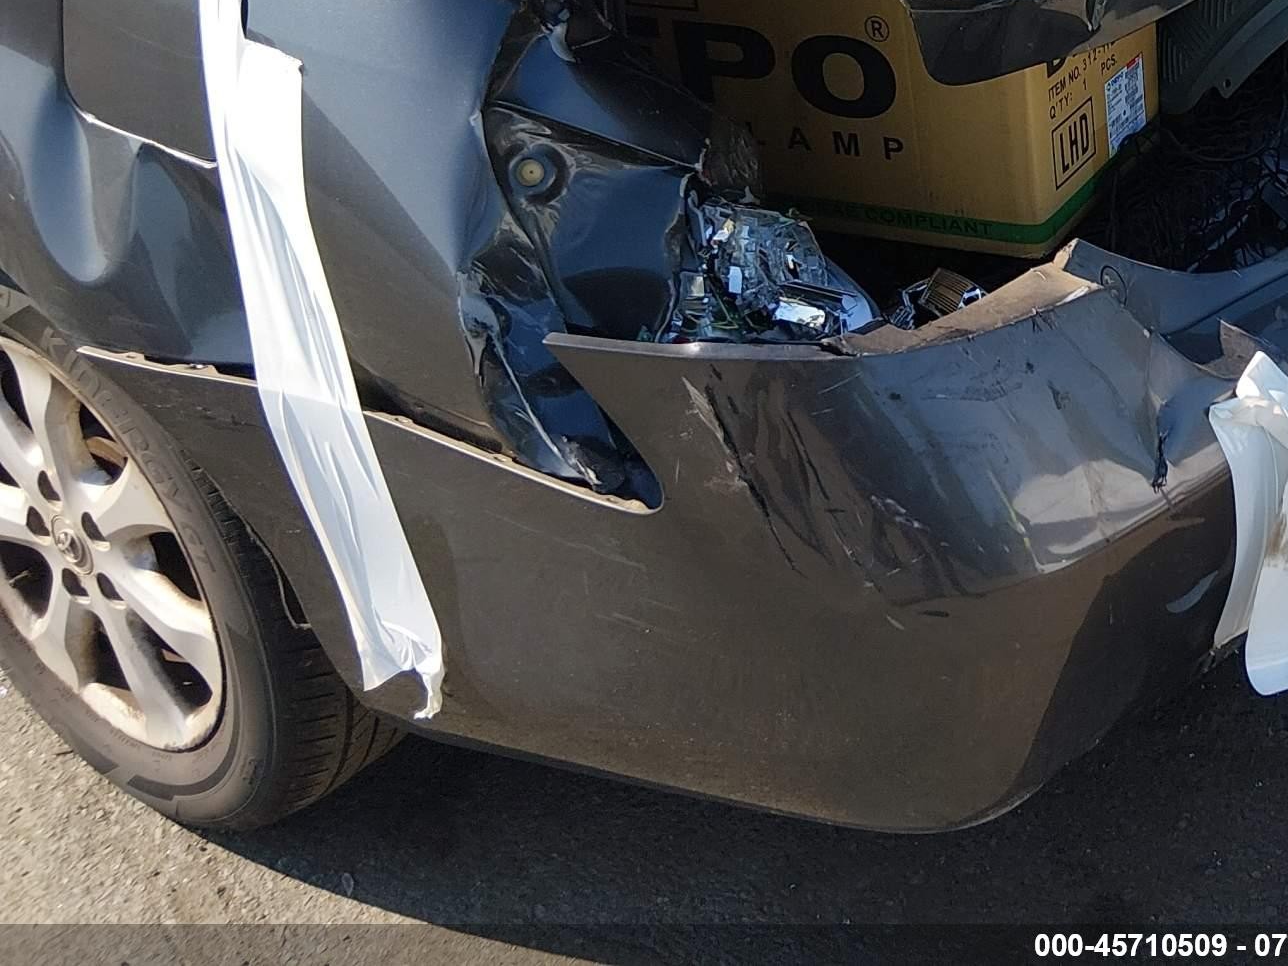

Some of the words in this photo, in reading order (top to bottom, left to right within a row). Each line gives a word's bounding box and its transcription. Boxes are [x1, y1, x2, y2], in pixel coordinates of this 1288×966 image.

[1048, 76, 1066, 101] ITEM
[1068, 65, 1081, 85] NO.
[1050, 92, 1073, 119] Q'TY:
[1101, 53, 1118, 74] PCS.
[1060, 113, 1090, 174] LHD
[865, 208, 993, 237] COMPLIANT
